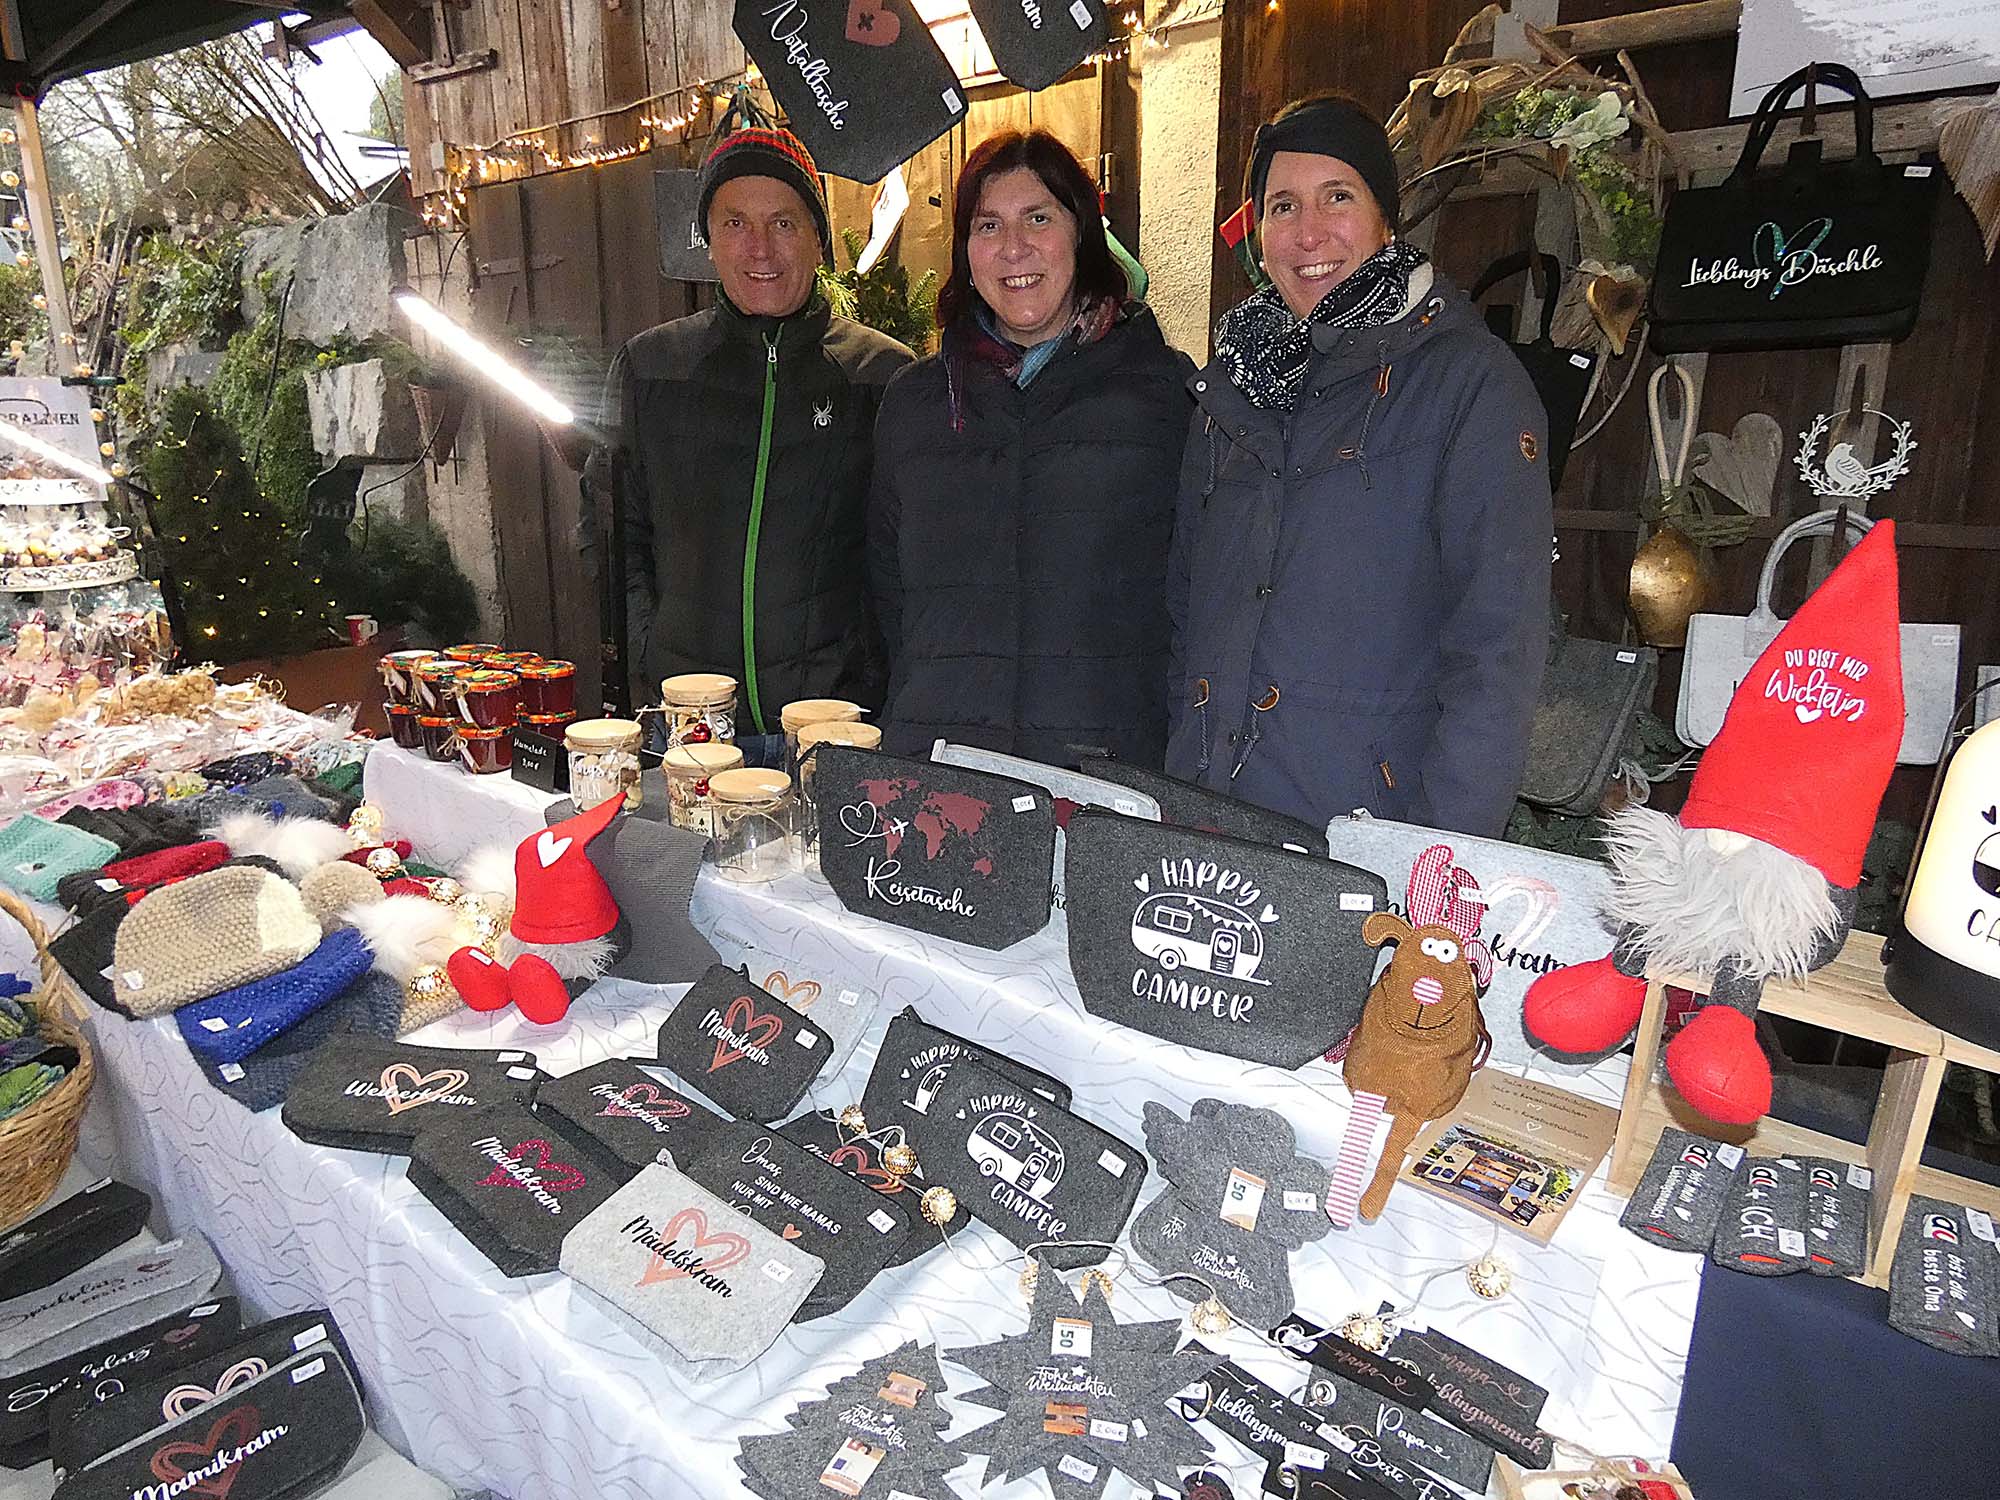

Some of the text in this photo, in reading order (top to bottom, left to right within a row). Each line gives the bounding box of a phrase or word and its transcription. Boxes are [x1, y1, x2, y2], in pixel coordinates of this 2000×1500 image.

[761, 0, 849, 130] Notfalltasche
[1681, 244, 1883, 289] Lieblings Däschle
[1784, 649, 1869, 682] DU BIST MIR
[1764, 668, 1865, 722] Wichtelig
[863, 856, 976, 917] Reisetasche
[1161, 858, 1261, 906] HAPPY
[1131, 968, 1254, 1023] CAMPER
[698, 1007, 770, 1066] Mamikram
[910, 1044, 961, 1069] HAPPY
[970, 1094, 1026, 1115] HAPPY
[471, 1136, 562, 1214] Mädelskram
[741, 1136, 784, 1178] Omas
[731, 1180, 755, 1201] NUR
[752, 1193, 774, 1210] MIT
[754, 1175, 842, 1235] SIND WIE MAMAS
[990, 1182, 1068, 1241] CAMPER
[1231, 1181, 1246, 1201] 50
[1740, 1206, 1775, 1240] ICH
[621, 1215, 733, 1299] Mädelskram
[1947, 1253, 1967, 1280] bist
[1923, 1249, 1944, 1312] beste Oma
[1060, 1328, 1074, 1349] 50
[1025, 1375, 1116, 1398] Weihnachten
[1034, 1366, 1069, 1382] Frohe
[1376, 1403, 1428, 1449] Papa
[130, 1425, 289, 1500] Mamikram
[1351, 1438, 1406, 1482] Beste
